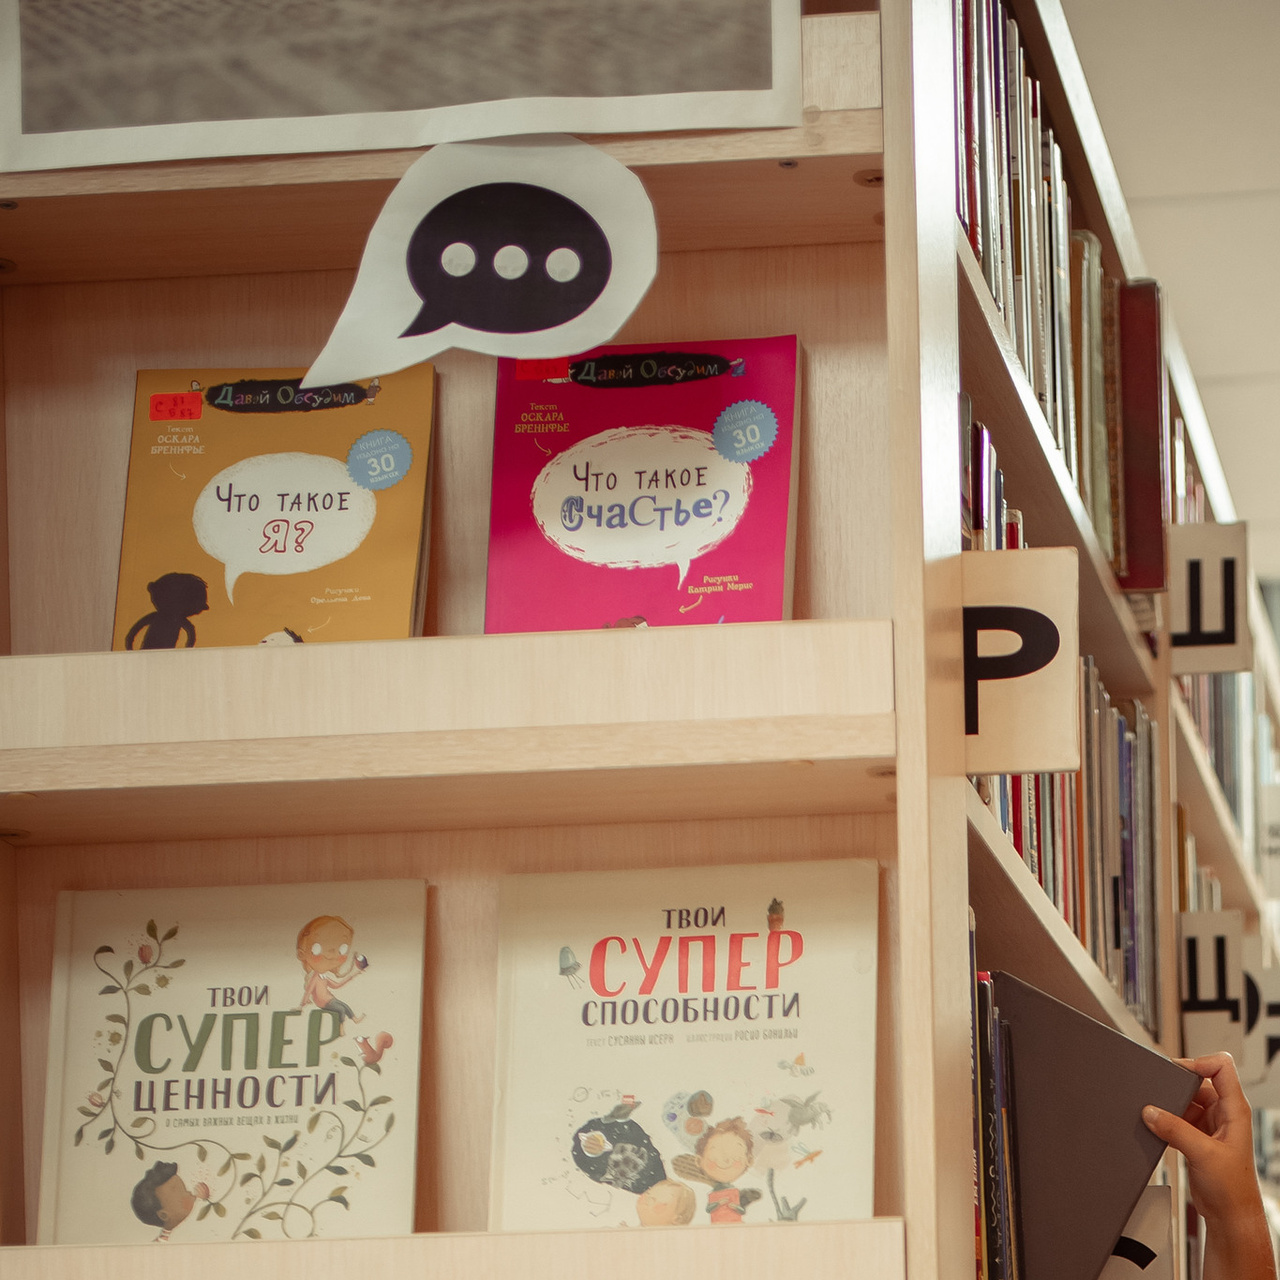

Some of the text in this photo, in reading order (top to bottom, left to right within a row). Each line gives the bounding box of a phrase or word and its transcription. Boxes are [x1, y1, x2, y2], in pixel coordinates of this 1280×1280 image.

[514, 423, 570, 434] БРЕНИФЬЕ
[520, 412, 565, 422] ОСКАРА
[157, 434, 200, 444] ОСКАРА
[359, 435, 393, 450] КНИГА
[732, 424, 761, 448] 30
[367, 453, 395, 476] 30
[258, 518, 315, 554] Я?
[962, 606, 1060, 735] Р
[661, 906, 726, 929] ТВОИ
[589, 930, 804, 998] СУПЕР
[207, 985, 269, 1008] ТВОИ
[580, 992, 801, 1027] СПОСОБНОСТИ
[134, 1009, 341, 1075] СУПЕР
[133, 1072, 337, 1114] ЦЕННОСТИ
